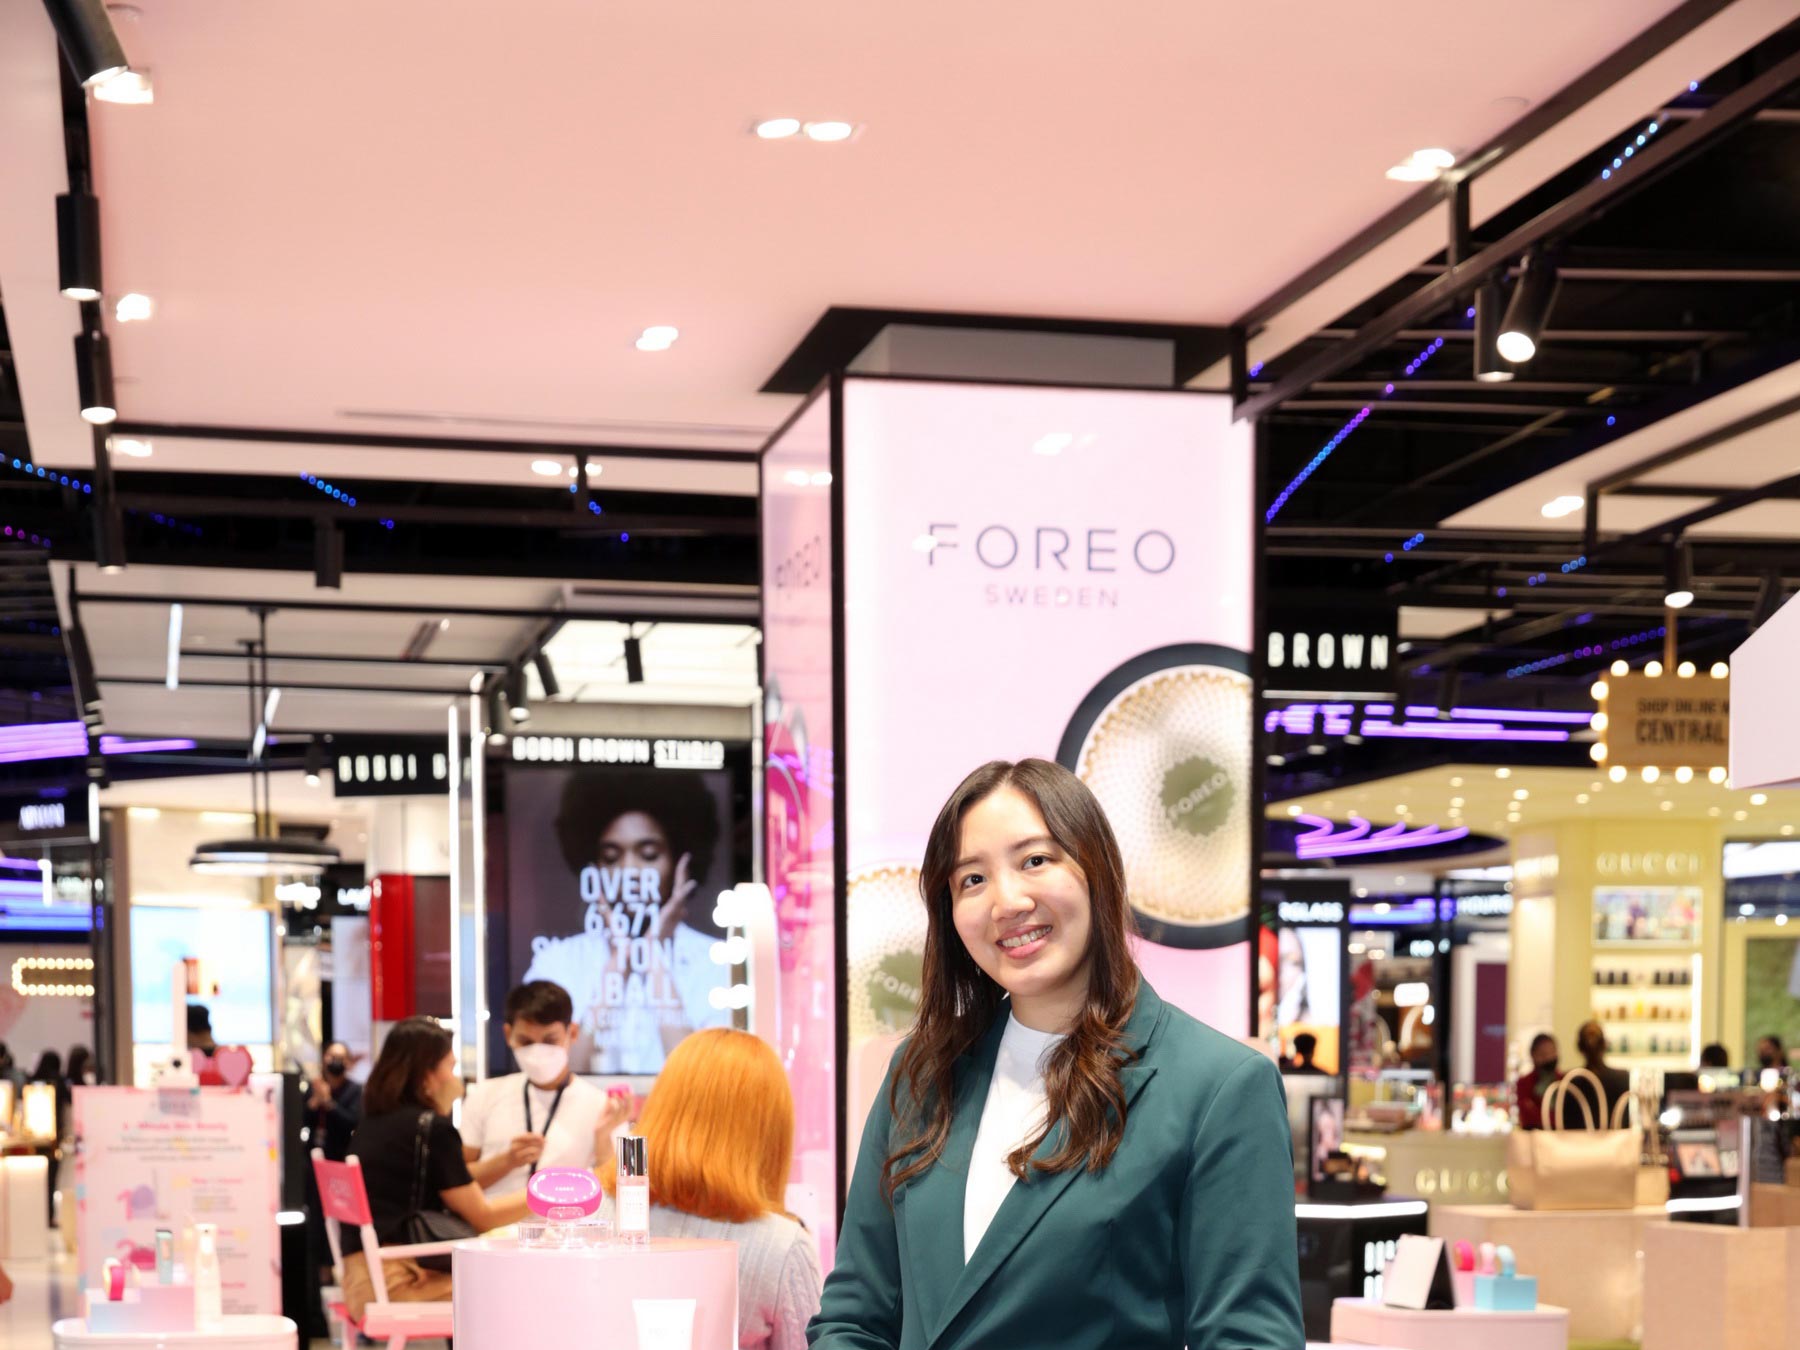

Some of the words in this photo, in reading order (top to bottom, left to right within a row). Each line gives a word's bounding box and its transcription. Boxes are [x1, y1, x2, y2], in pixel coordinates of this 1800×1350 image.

[928, 523, 1176, 574] FOREO
[984, 584, 1118, 608] SWEDEN
[1268, 632, 1389, 669] BROWN
[1636, 719, 1726, 745] CENTRAL
[1596, 852, 1699, 876] GUCCI
[580, 866, 662, 902] OVER
